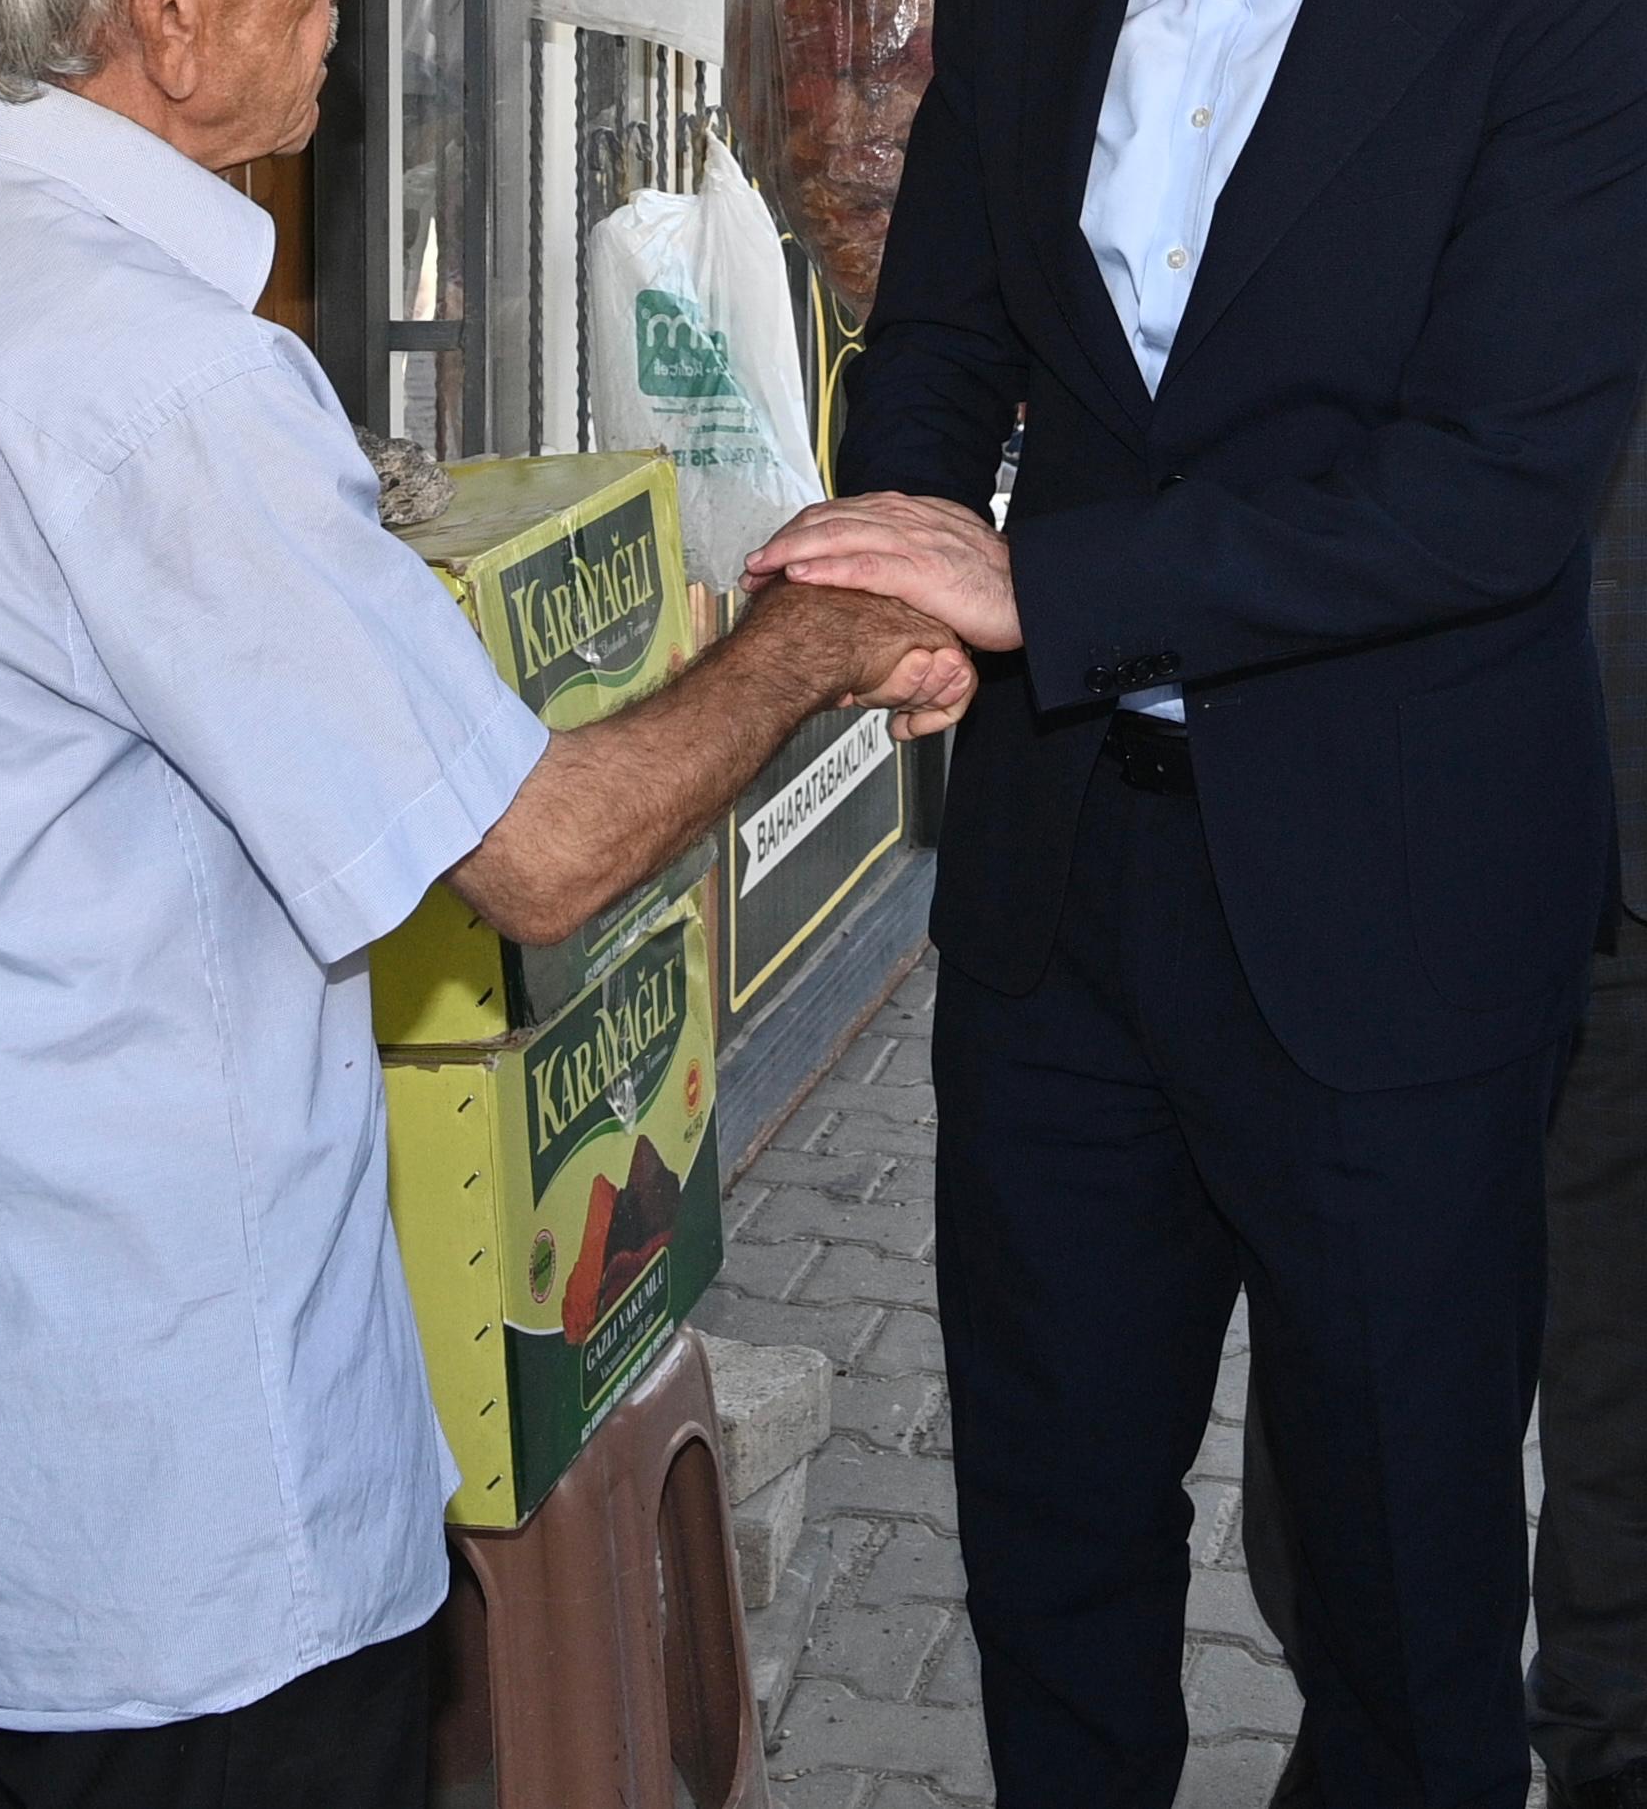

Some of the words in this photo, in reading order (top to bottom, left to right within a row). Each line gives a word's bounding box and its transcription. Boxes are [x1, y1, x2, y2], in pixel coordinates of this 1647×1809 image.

[511, 531, 655, 679] KARAYAĞLI
[757, 714, 880, 863] BAHARAT&BAKLİYAT
[532, 967, 677, 1154] KARAYAĞLI
